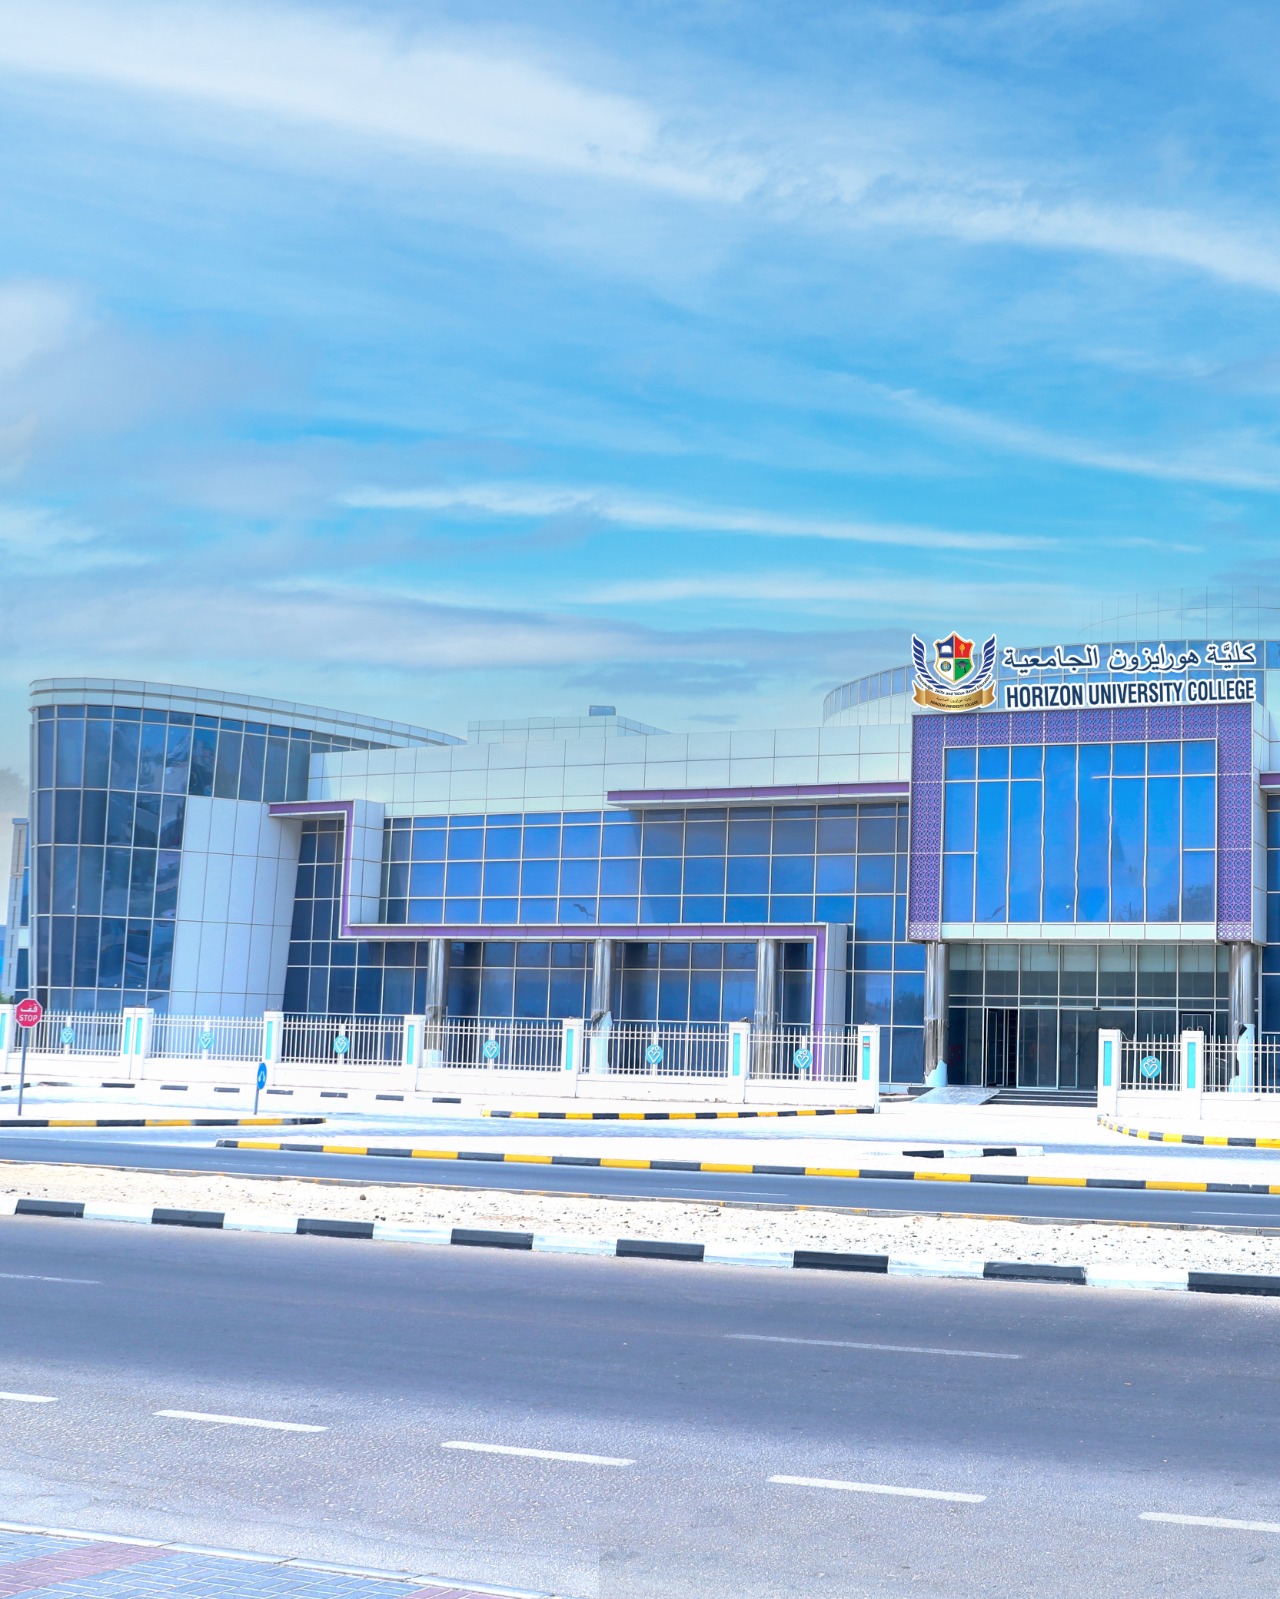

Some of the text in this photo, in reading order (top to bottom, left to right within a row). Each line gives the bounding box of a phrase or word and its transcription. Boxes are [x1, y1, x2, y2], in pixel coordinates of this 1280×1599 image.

[1004, 646, 1098, 674] الجامعية
[1109, 646, 1199, 672] هورايزون
[1006, 679, 1254, 708] HORIZON UNIVERSITY COLLEGE
[19, 1014, 38, 1022] STOP
